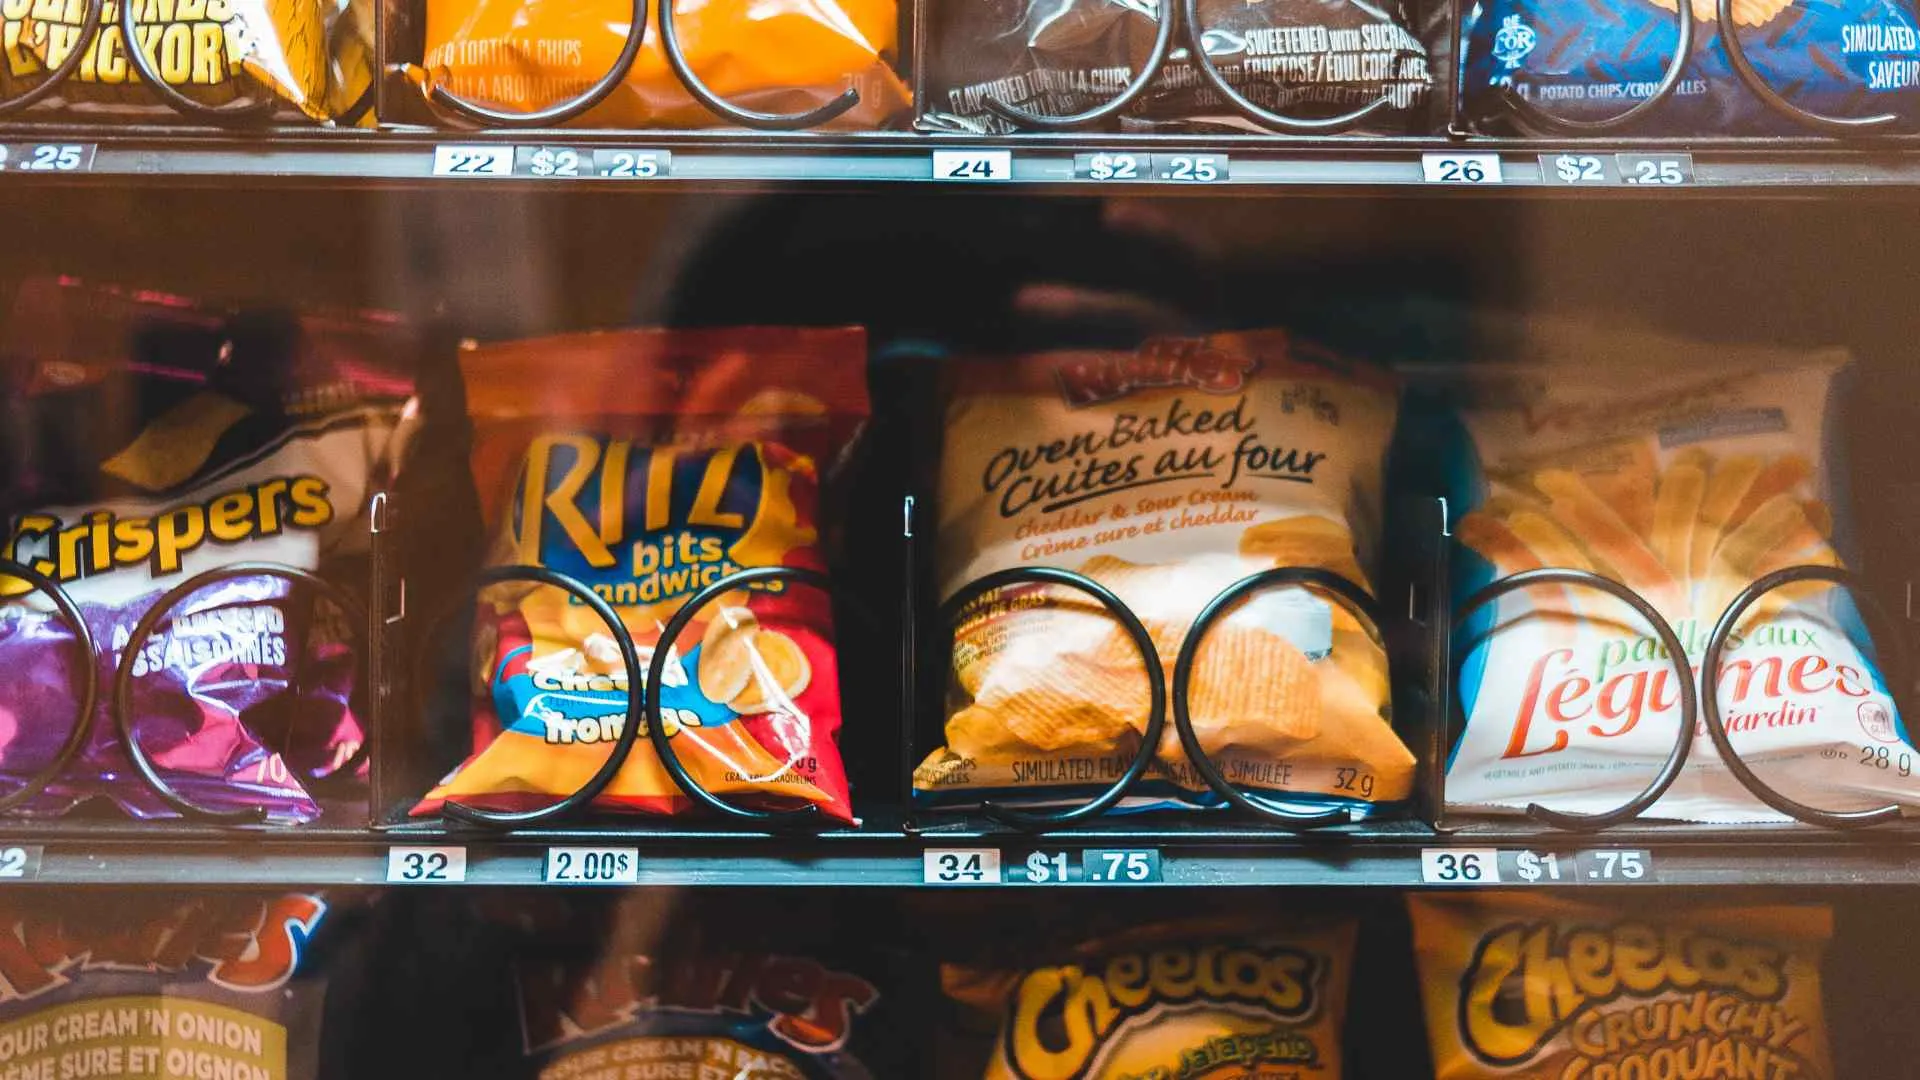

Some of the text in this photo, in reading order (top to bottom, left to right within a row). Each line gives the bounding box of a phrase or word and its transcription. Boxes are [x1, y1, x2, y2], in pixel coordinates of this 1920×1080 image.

[536, 38, 582, 67] CHIPS
[1245, 24, 1330, 56] SWEETENED
[1329, 28, 1362, 53] WITH
[1841, 23, 1916, 53] SIMULATED
[1090, 66, 1132, 94] CHIPS
[1867, 60, 1920, 89] SAVEUR
[1539, 84, 1585, 100] POTATO
[19, 145, 82, 171] .25
[449, 151, 497, 174] 22
[530, 147, 658, 178] $2 .25
[948, 159, 994, 178] 24
[1089, 153, 1218, 181] $2 .25
[1438, 159, 1486, 182] 26
[1555, 153, 1683, 184] $2 .25
[983, 428, 1106, 494] Oven
[1107, 394, 1257, 448] Baked
[1000, 433, 1327, 518] Cuites au four
[518, 432, 745, 568] RITZ
[1109, 503, 1131, 520] &
[0, 474, 335, 596] Crispers
[1143, 518, 1166, 537] et
[1169, 506, 1260, 530] cheddar
[631, 530, 724, 578] bits
[1753, 623, 1821, 651] aux
[1724, 700, 1817, 739] jardin
[807, 757, 818, 774] g
[1012, 757, 1095, 784] SIMULATED
[1229, 760, 1294, 786] SIMULÉE
[1859, 745, 1912, 777] 28 g
[1333, 766, 1374, 797] 32 g
[402, 852, 449, 880] 32
[556, 851, 629, 880] 2.00$
[938, 854, 983, 881] 34
[1025, 850, 1150, 882] $1 .75
[1437, 854, 1482, 880] 36
[1516, 850, 1644, 882] $1 .75
[1465, 921, 1781, 1060] Cheetos
[1012, 943, 1306, 1080] Cheetos
[1571, 991, 1809, 1057] CRUNCHY
[53, 1007, 139, 1043] CREAM
[144, 1011, 170, 1038] 'N
[175, 1011, 263, 1057] ONION
[60, 1046, 124, 1080] SURE
[128, 1046, 161, 1073] ET
[165, 1046, 271, 1080] OIGNON
